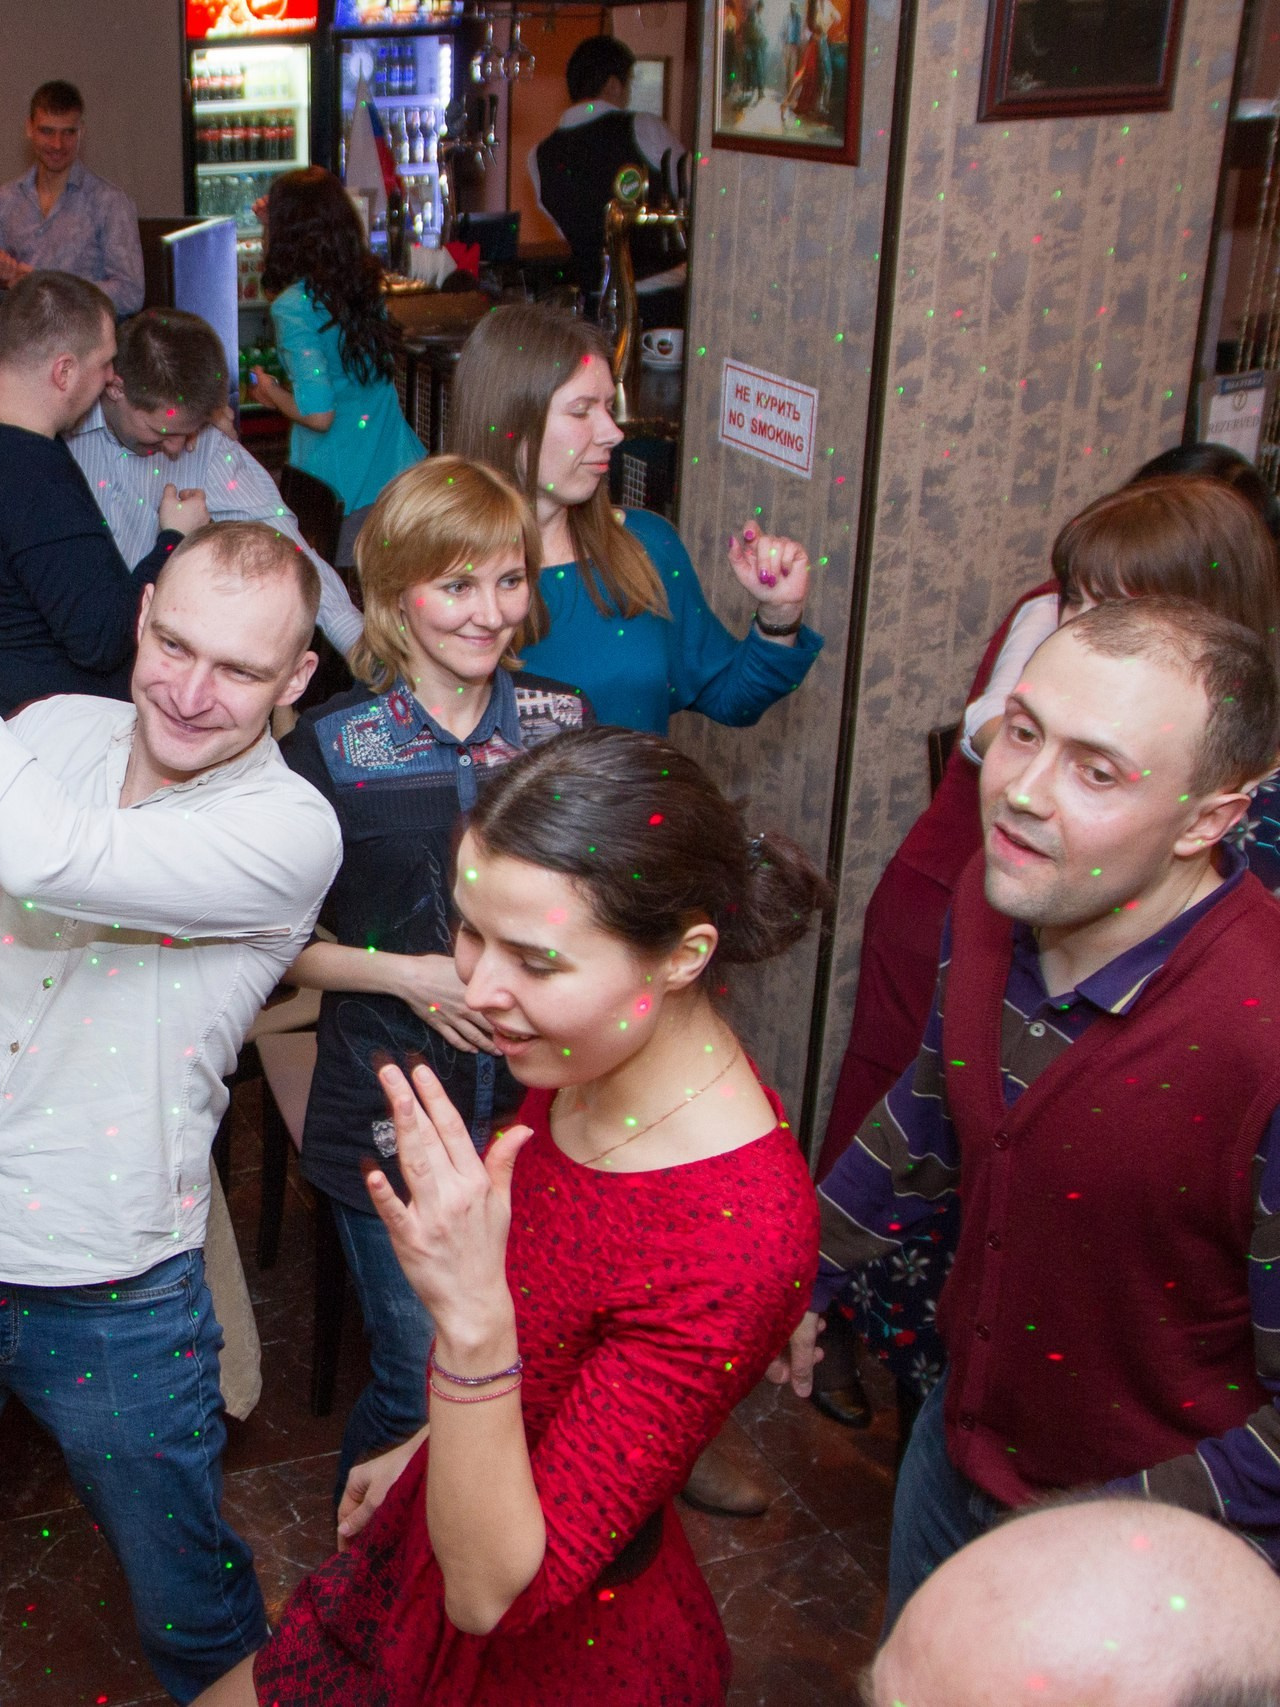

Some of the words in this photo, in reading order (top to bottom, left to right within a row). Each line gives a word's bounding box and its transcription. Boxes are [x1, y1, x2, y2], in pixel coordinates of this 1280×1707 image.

[735, 383, 751, 403] НЕ
[756, 390, 801, 422] КУРИТЬ
[728, 408, 745, 429] NO
[750, 417, 804, 452] SMOKING
